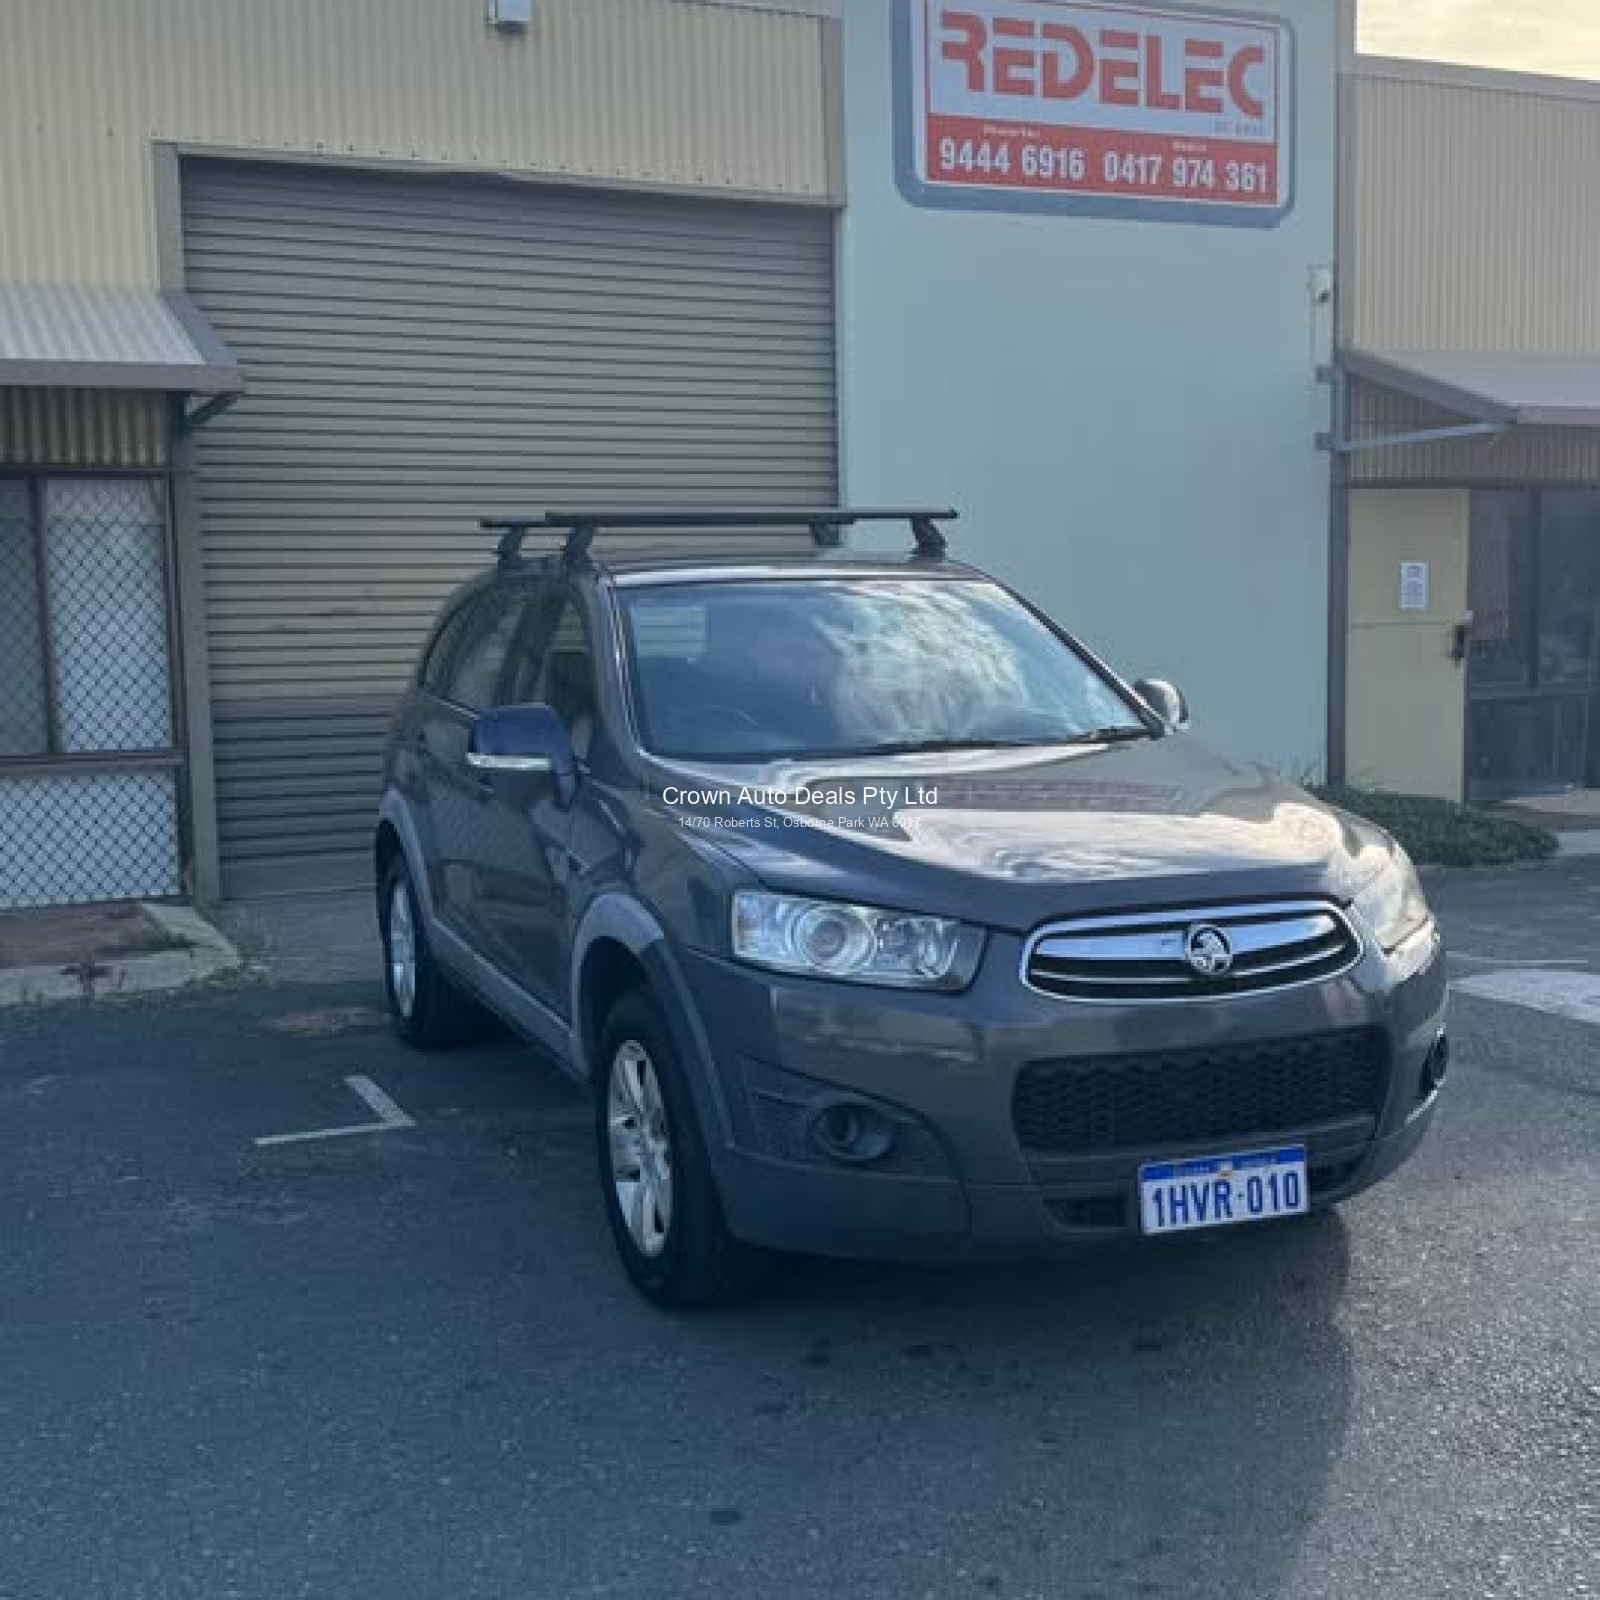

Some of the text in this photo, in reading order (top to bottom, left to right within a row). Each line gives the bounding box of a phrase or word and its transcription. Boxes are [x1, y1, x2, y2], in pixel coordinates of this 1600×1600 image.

[940, 10, 1264, 118] REDELEC
[939, 138, 1085, 180] 9444 6916
[1103, 151, 1162, 184] 0417
[1172, 156, 1215, 188] 974
